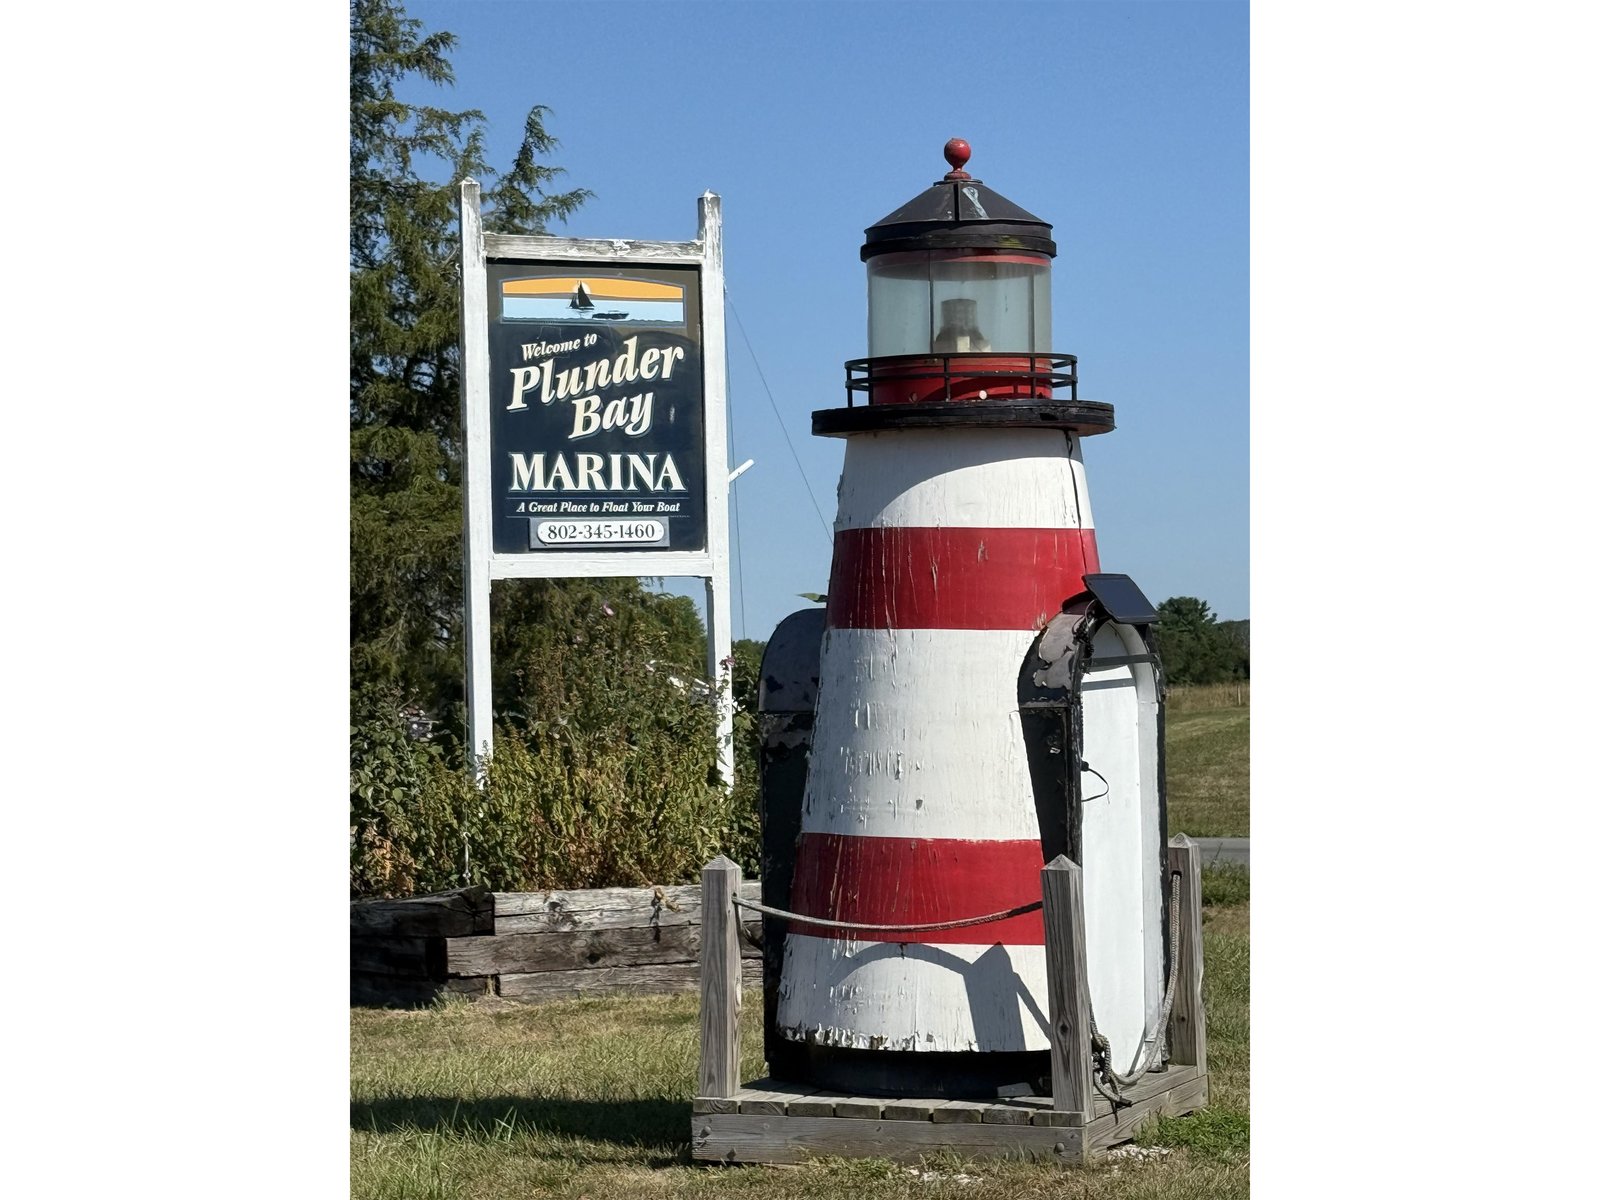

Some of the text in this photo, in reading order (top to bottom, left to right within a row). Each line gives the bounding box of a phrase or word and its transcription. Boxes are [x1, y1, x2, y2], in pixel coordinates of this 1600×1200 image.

[521, 333, 598, 361] Welcome to
[506, 336, 685, 411] Plunder
[568, 392, 655, 440] Bay
[508, 452, 688, 492] MARINA
[516, 501, 681, 513] A Great Place to Float Your Boat
[547, 523, 656, 540] 802-345-1460
